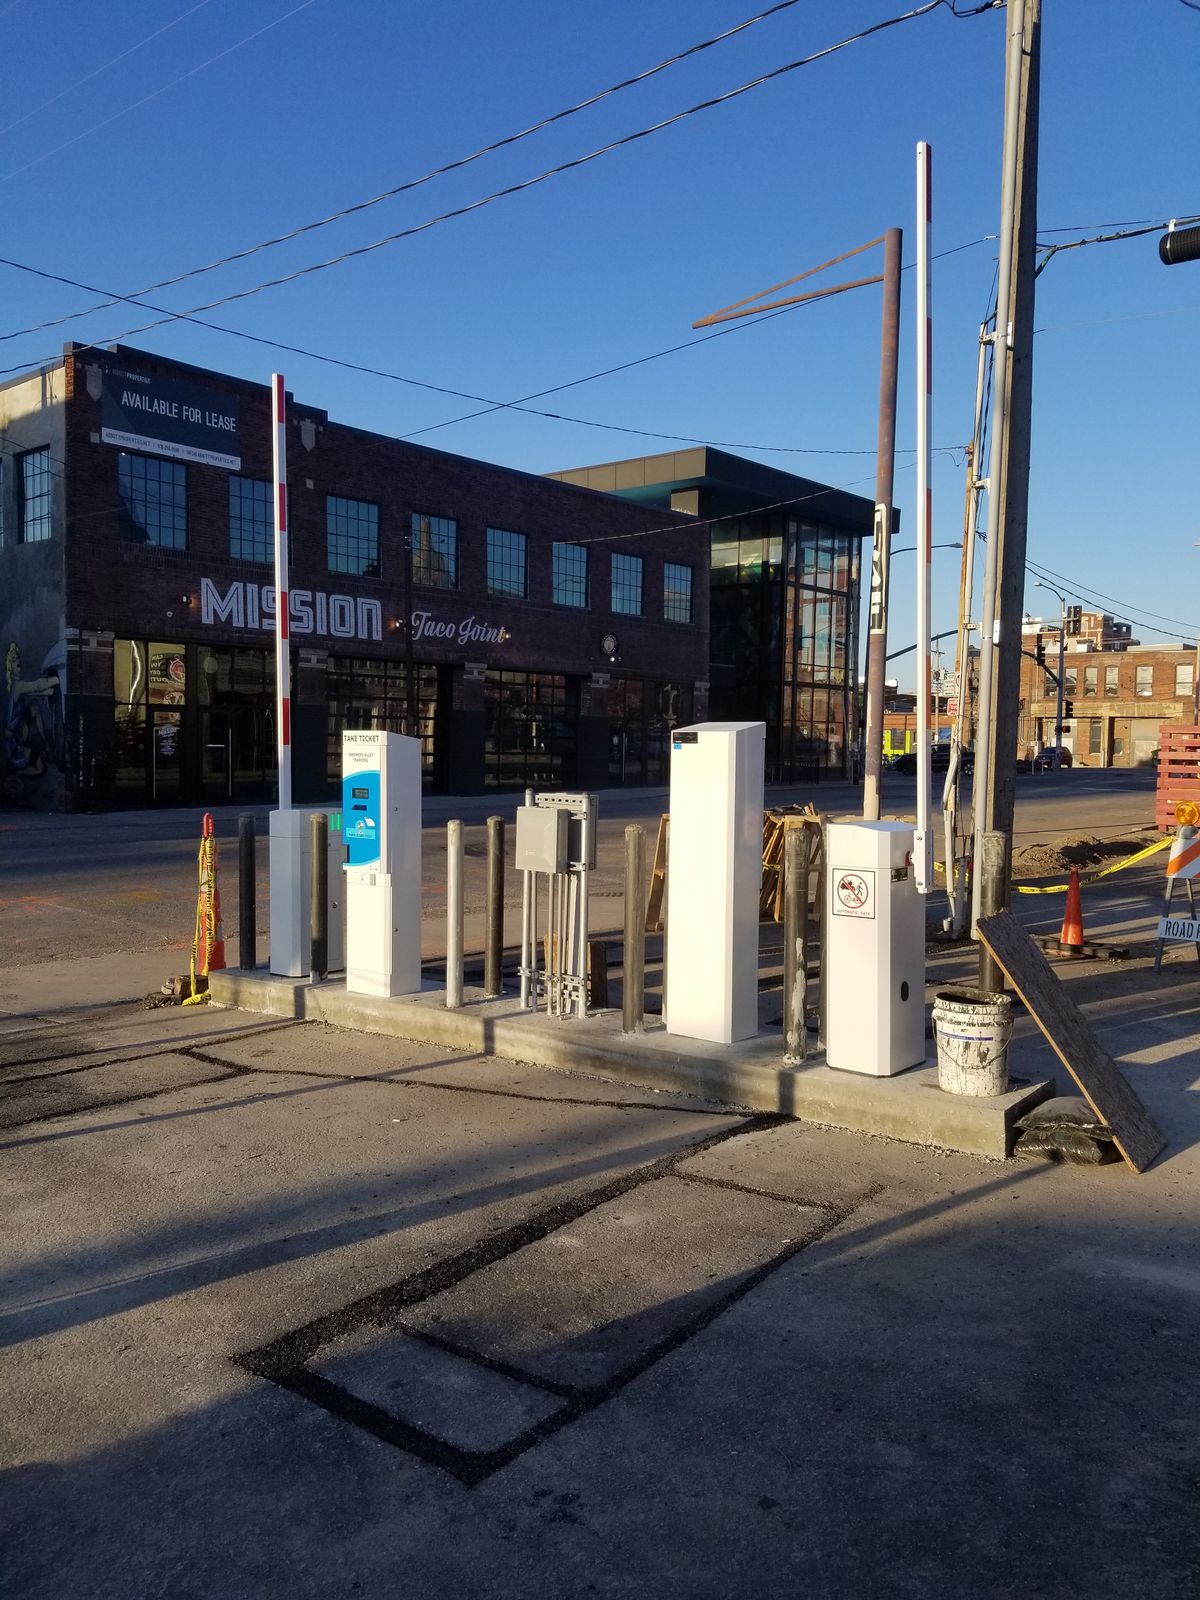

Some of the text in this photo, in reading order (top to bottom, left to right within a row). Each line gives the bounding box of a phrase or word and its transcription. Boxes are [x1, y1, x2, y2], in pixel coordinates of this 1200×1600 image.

[121, 390, 236, 432] AVAILABLE FOR LEASE
[200, 577, 383, 641] MISSION
[411, 611, 507, 645] Taco Joint
[344, 734, 379, 742] TAKE TICKET
[1164, 920, 1194, 938] ROAD
